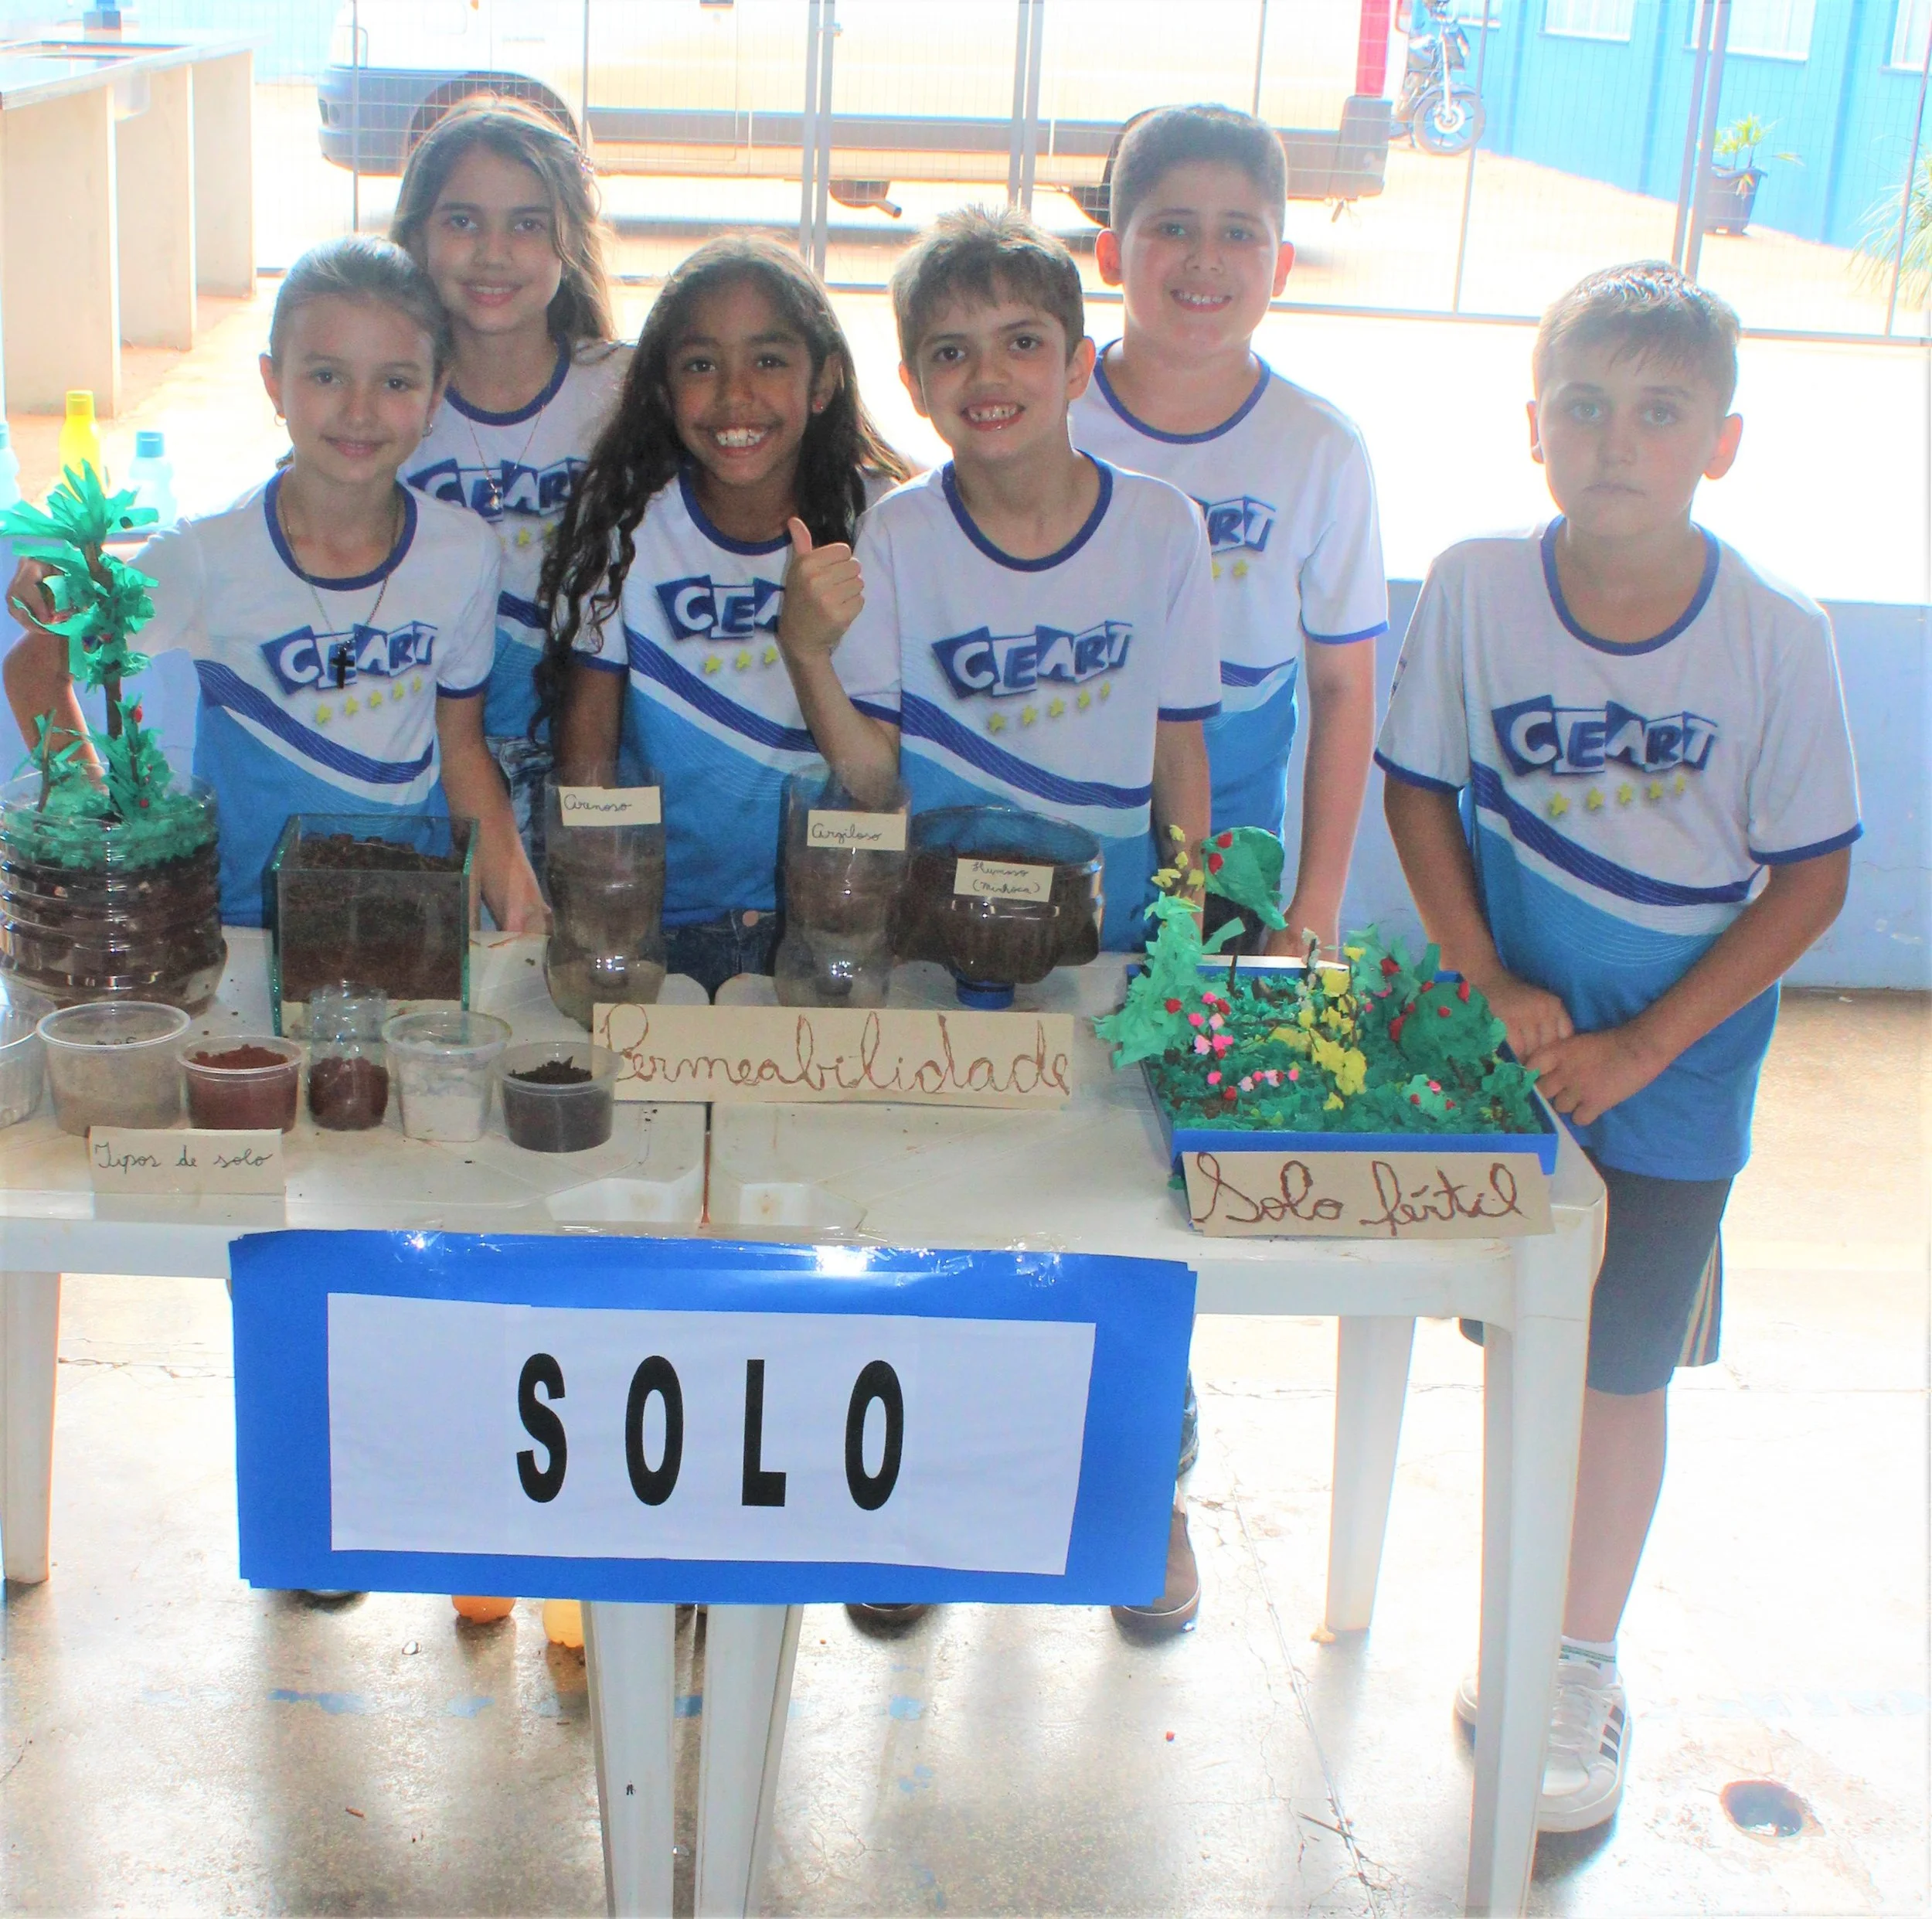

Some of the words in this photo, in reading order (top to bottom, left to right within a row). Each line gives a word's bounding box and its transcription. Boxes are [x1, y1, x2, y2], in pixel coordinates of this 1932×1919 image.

[410, 459, 586, 518] CEAR
[267, 623, 437, 690] CEART
[937, 623, 1131, 694] CEART
[1498, 700, 1717, 773] CEART
[599, 1002, 1070, 1097] Permeabilidade
[94, 1142, 162, 1175] Tipos
[175, 1144, 199, 1168] de
[213, 1148, 274, 1168] solo
[1191, 1152, 1345, 1223] Solo
[1359, 1159, 1533, 1237] fértil
